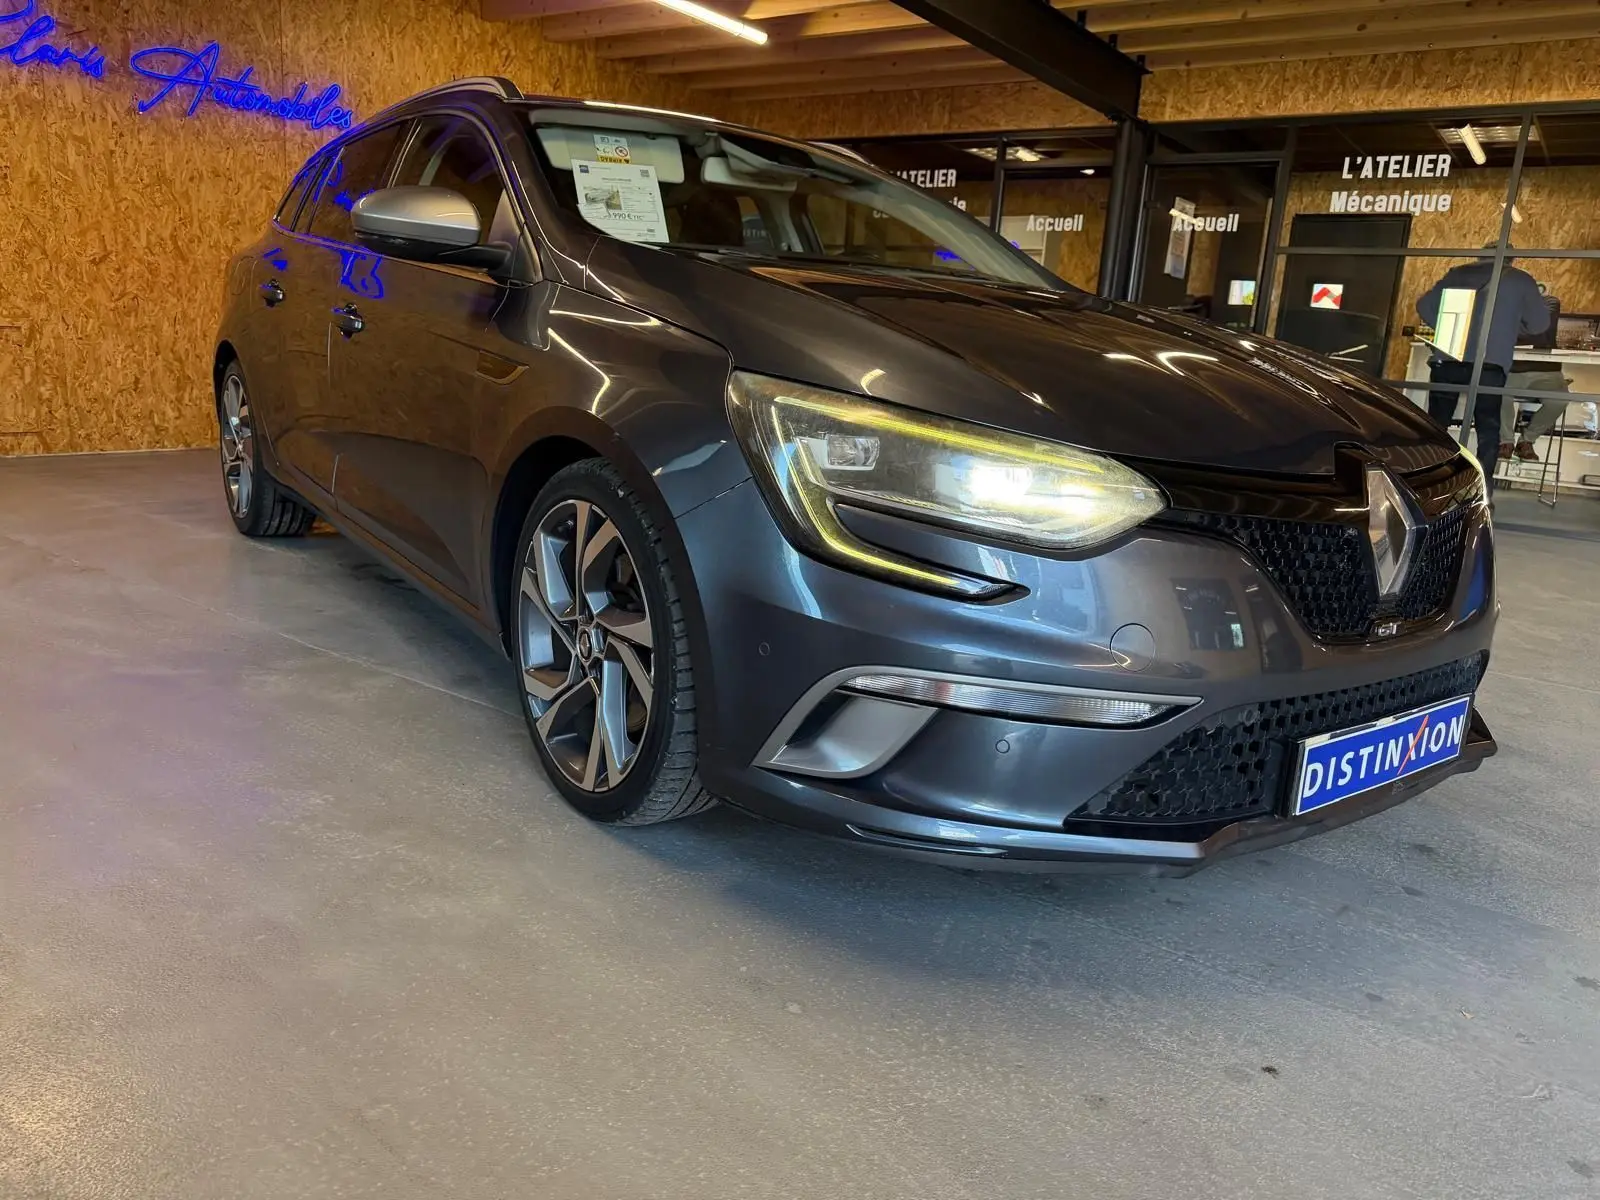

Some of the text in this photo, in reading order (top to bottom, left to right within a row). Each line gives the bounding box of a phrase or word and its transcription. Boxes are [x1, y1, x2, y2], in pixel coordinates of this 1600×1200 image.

[131, 40, 352, 129] Automobiles
[1342, 154, 1452, 179] L'ATELIER
[1329, 190, 1452, 216] Mécanique
[1026, 214, 1084, 231] Accueil
[1302, 714, 1465, 799] DISTINXION
